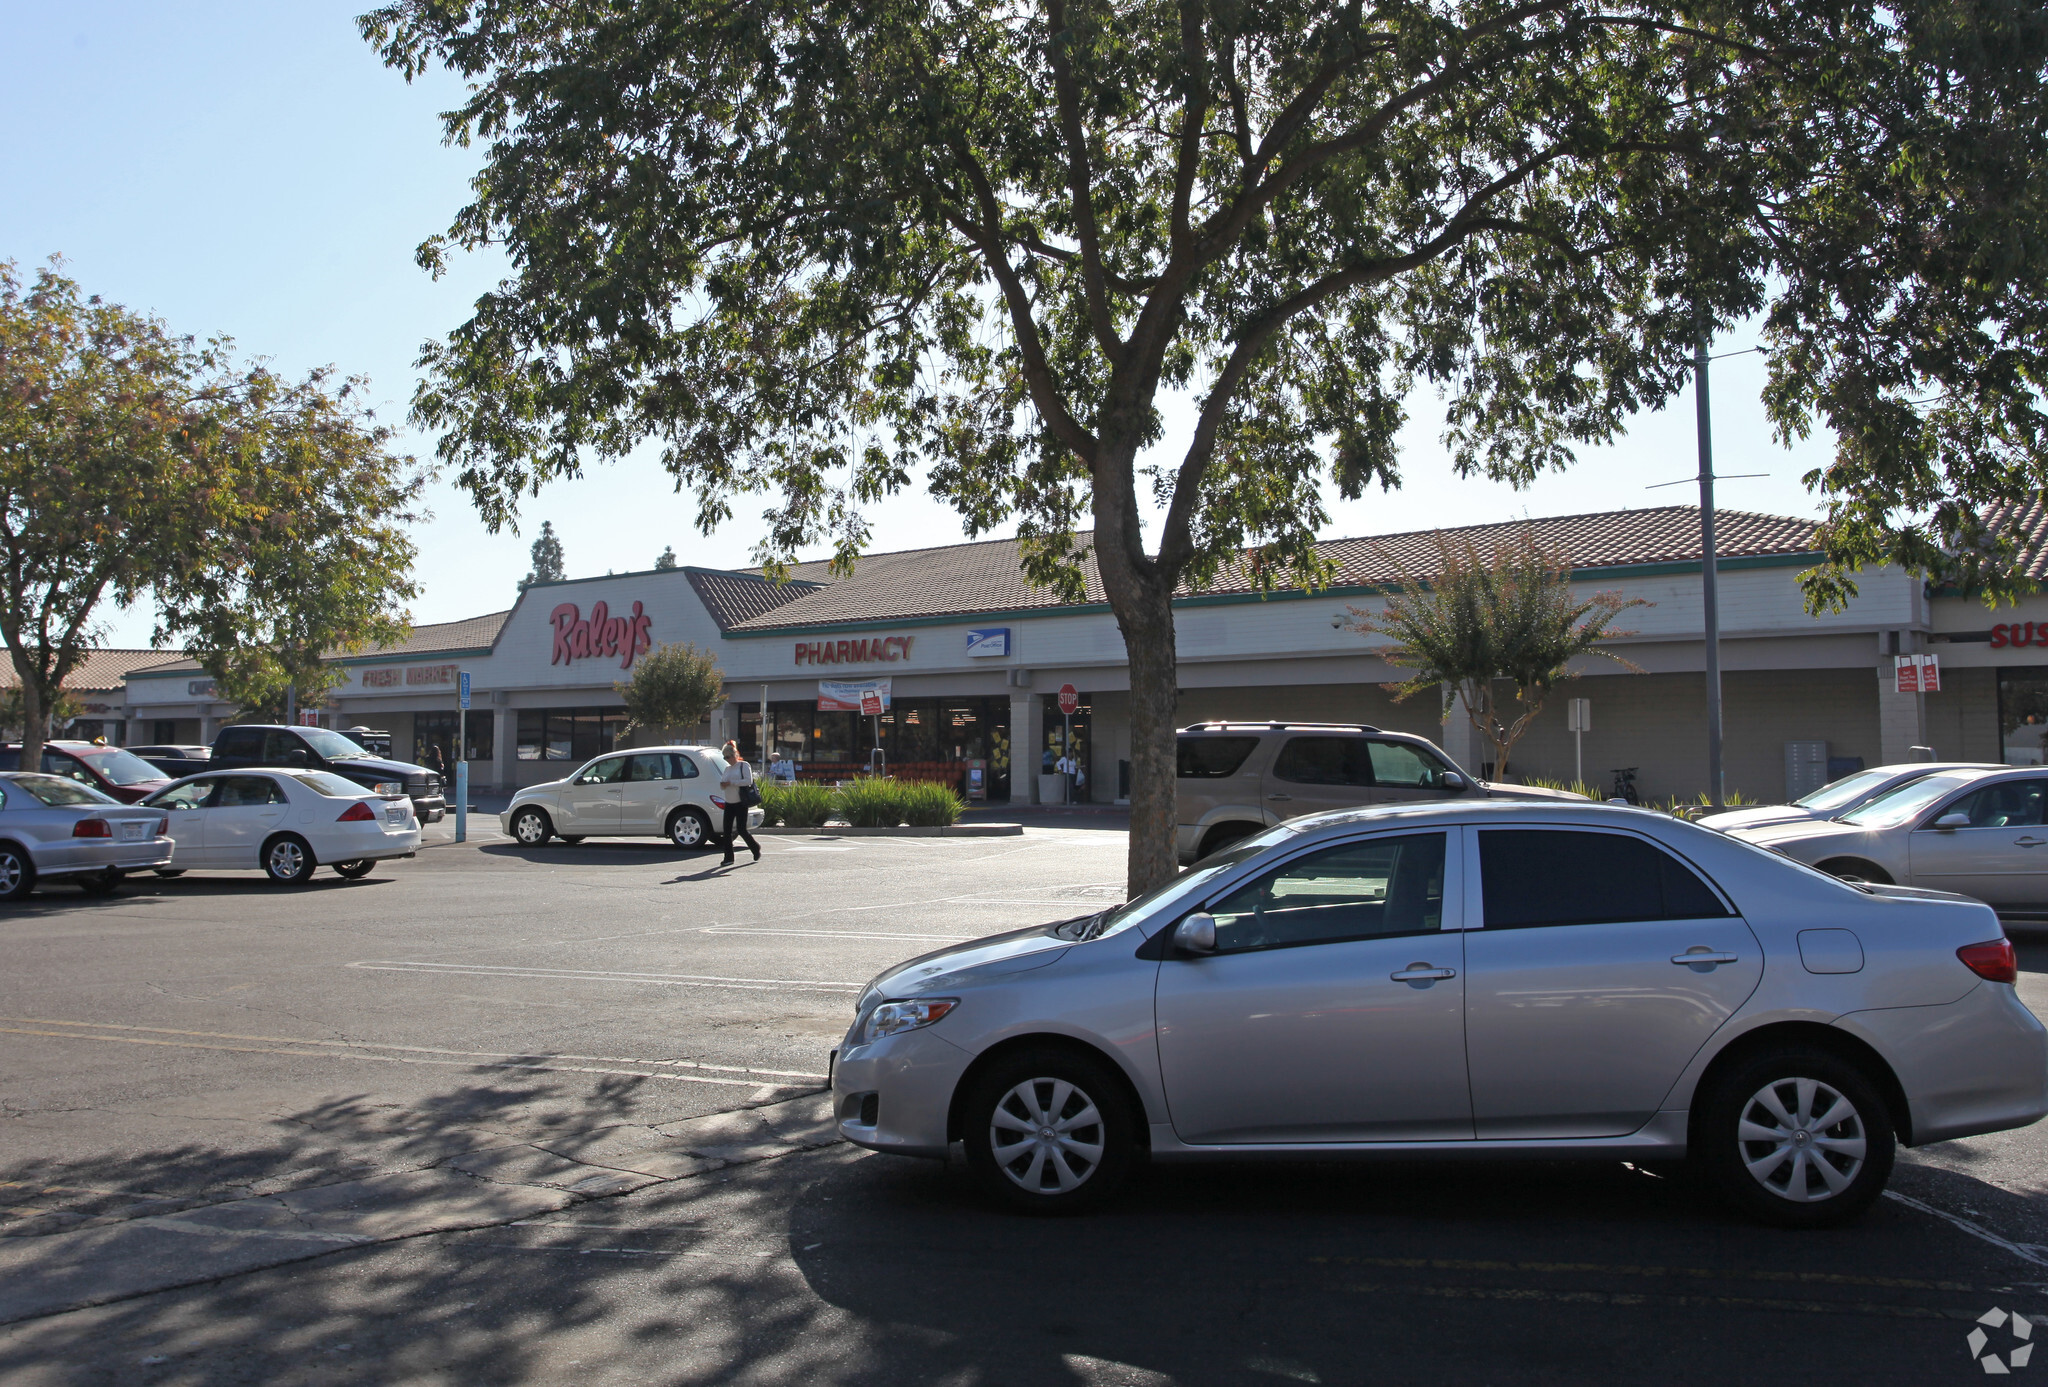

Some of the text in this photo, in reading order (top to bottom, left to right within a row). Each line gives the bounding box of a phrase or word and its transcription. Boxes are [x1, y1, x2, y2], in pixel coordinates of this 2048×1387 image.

[549, 600, 652, 669] Raley's
[795, 636, 915, 665] PHARMACY
[362, 664, 459, 688] FRESH MARKET
[1060, 693, 1077, 704] STOP
